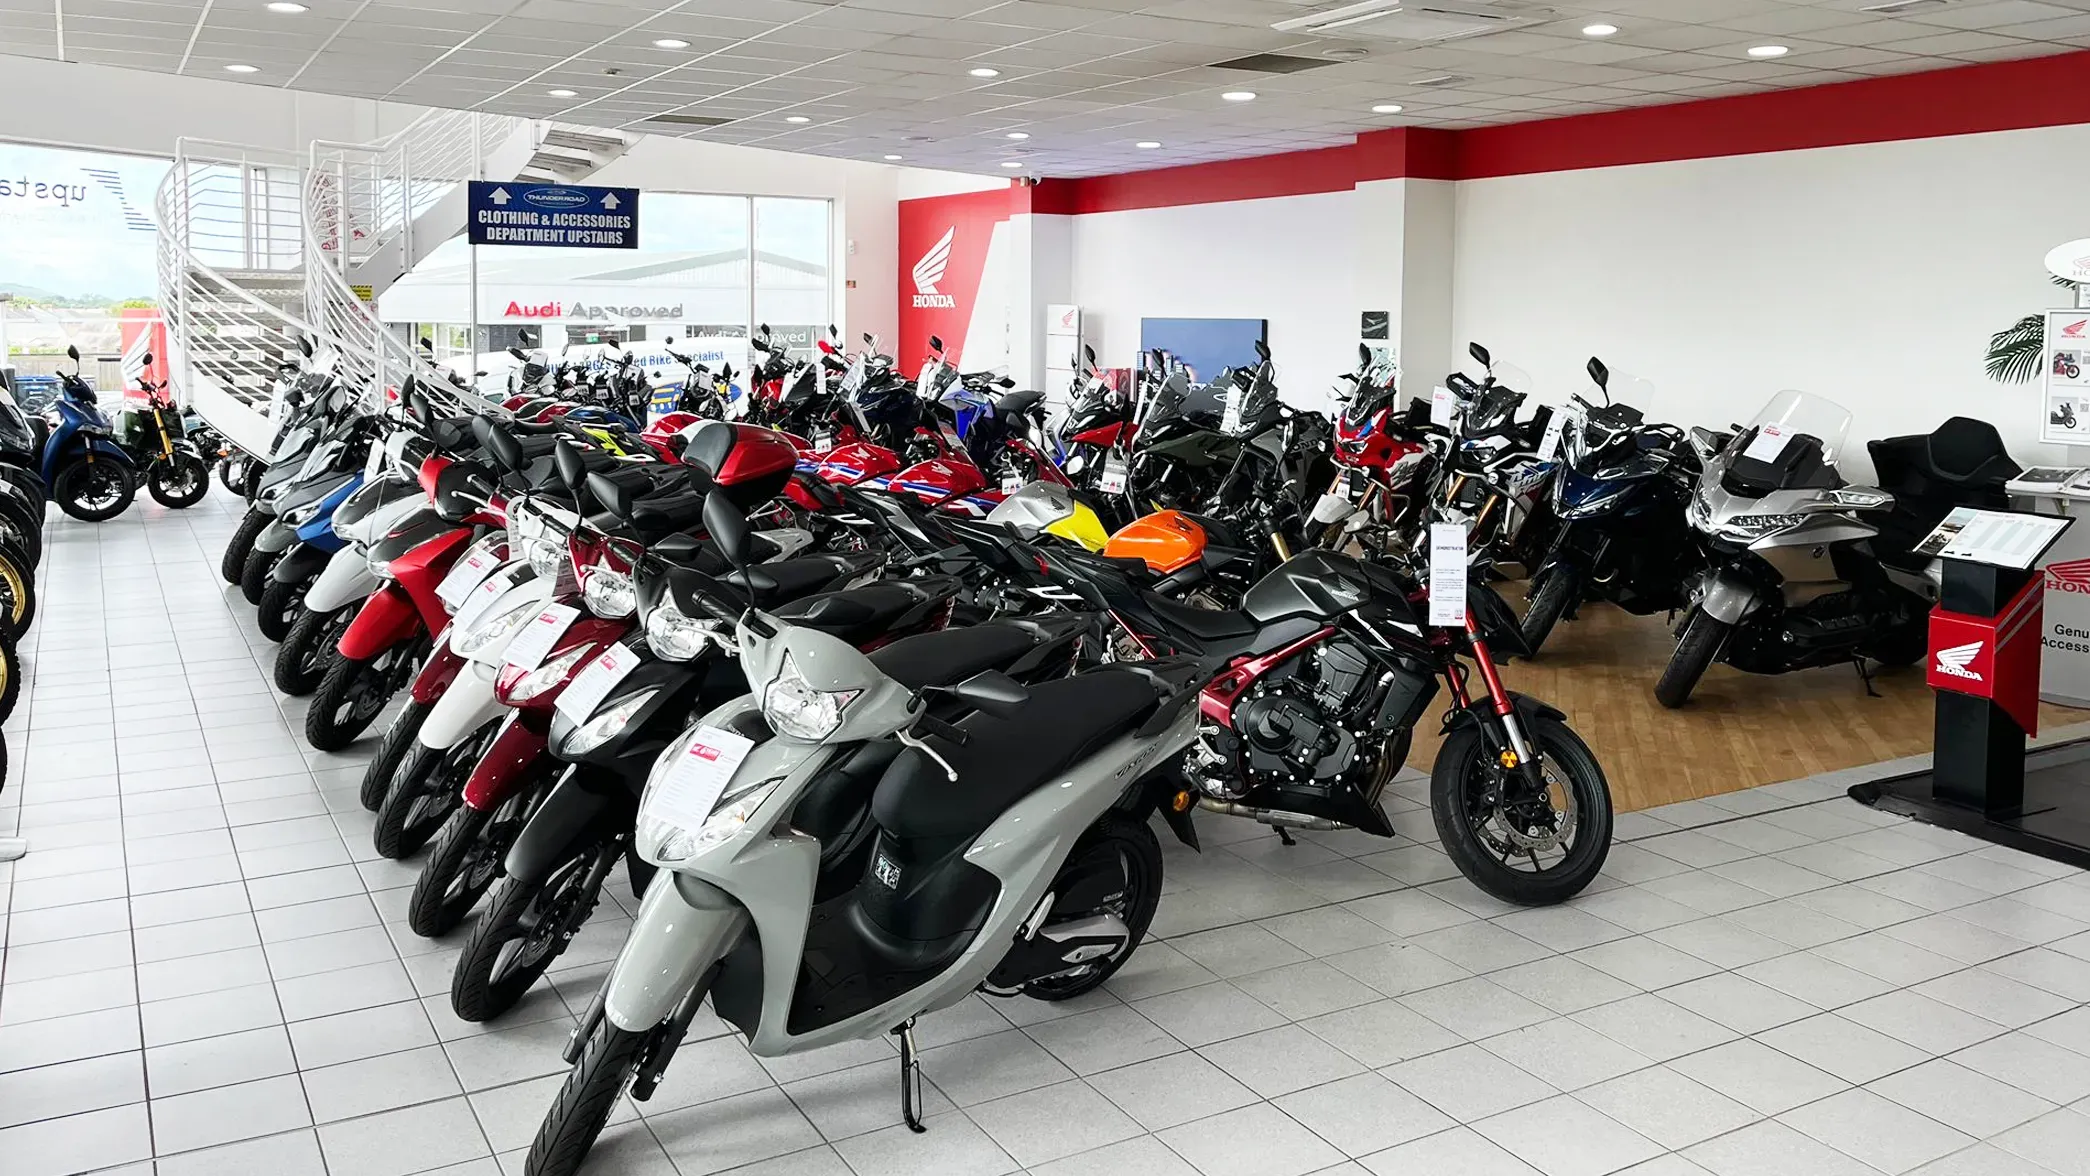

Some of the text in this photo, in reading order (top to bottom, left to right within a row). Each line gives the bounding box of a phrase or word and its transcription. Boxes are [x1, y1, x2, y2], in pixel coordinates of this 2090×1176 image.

[478, 210, 631, 229] CLOTHING & ACCESSORIES
[486, 227, 624, 245] DEPARTMENT UPSTAIRS
[912, 294, 956, 308] HONDA
[503, 301, 683, 321] Audi Approved
[649, 354, 672, 367] Bike
[2054, 623, 2090, 639] Genu
[2040, 636, 2090, 653] Access
[1935, 664, 1984, 682] HONDA
